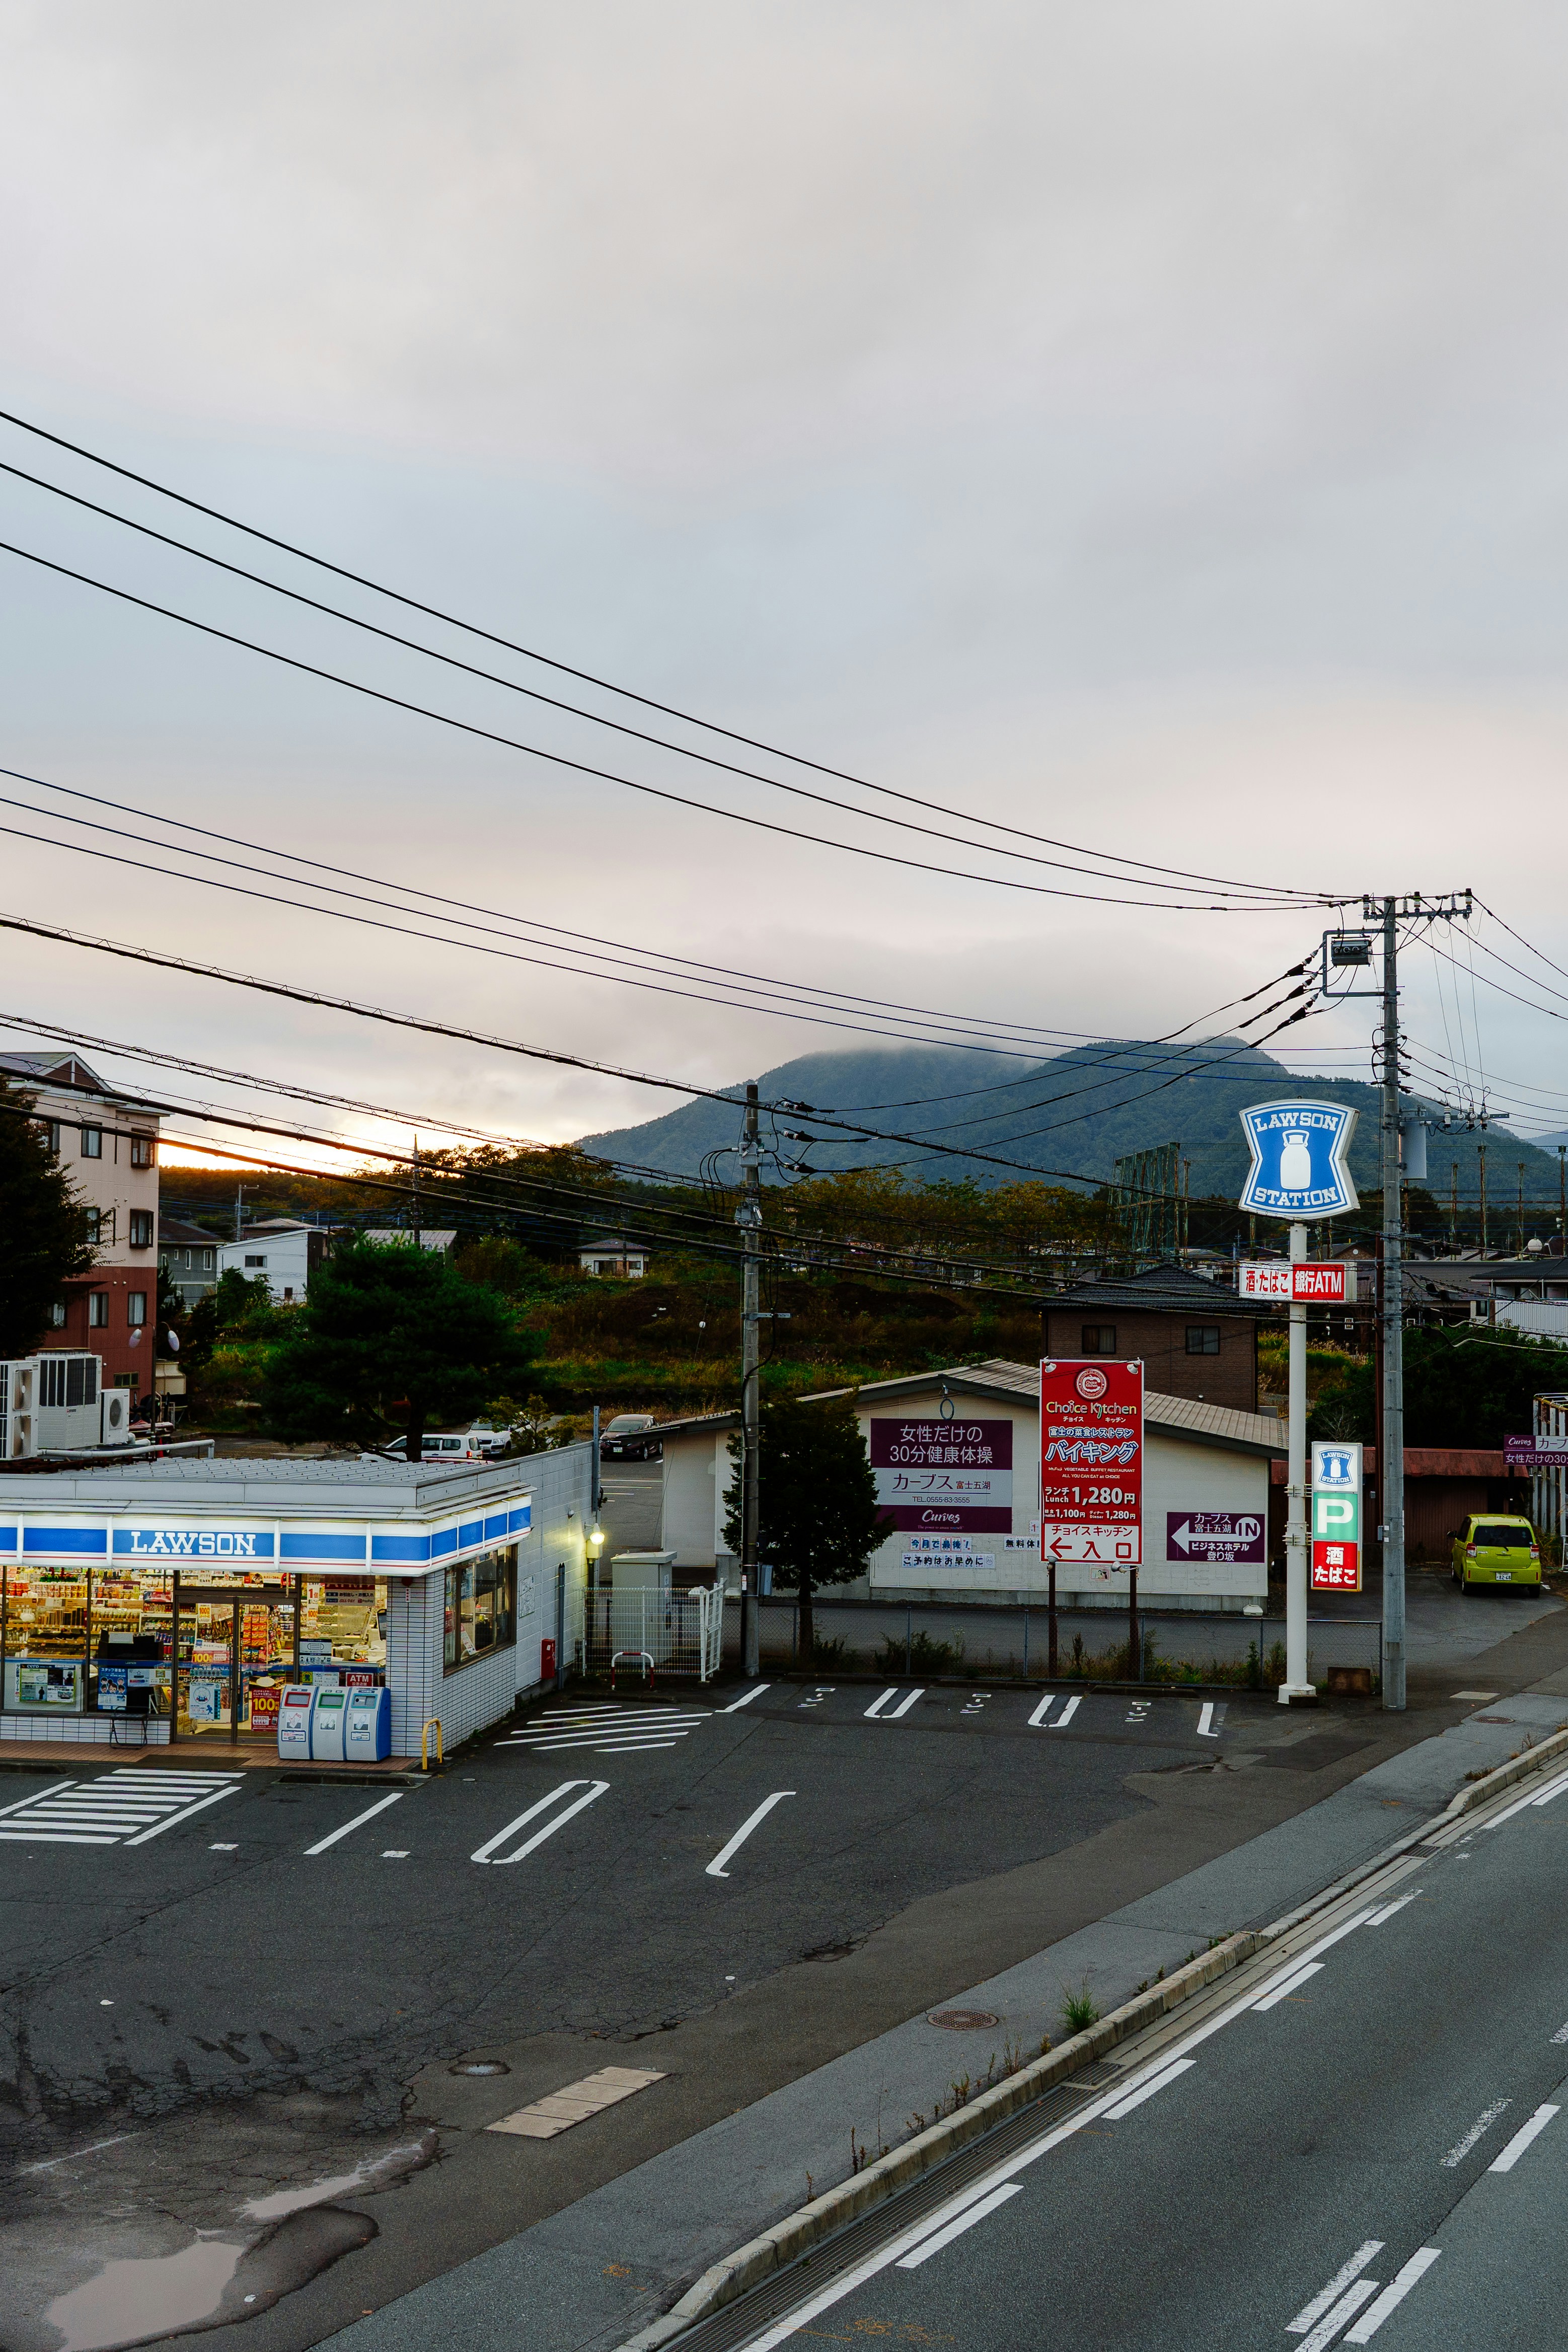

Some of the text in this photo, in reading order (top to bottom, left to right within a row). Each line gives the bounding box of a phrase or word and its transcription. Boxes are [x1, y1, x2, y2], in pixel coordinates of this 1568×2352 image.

[1254, 1112, 1338, 1132] LAWSON
[1254, 1187, 1338, 1206] STATION
[1246, 1270, 1341, 1293] 酒・たばこ 銀行ATM
[1047, 1400, 1137, 1419] Choice Kitchen
[901, 1425, 982, 1442] 女性だけの
[1049, 1426, 1134, 1438] 富士の菜食レストラン
[889, 1445, 993, 1464] 30分健康体操
[1045, 1439, 1139, 1464] バイキング
[1506, 1454, 1568, 1463] 女性だけの30
[892, 1473, 991, 1490] カーブス 富士五湖
[1045, 1487, 1135, 1505] ランチ 1,280円
[922, 1510, 960, 1523] Curves
[1056, 1509, 1085, 1518] 1,100円
[1105, 1511, 1136, 1519] 1,280円
[1194, 1513, 1231, 1523] カーブス
[1317, 1498, 1353, 1533] P
[1194, 1524, 1231, 1533] 富士五湖
[1238, 1523, 1257, 1536] IN
[131, 1531, 256, 1555] LAWSON
[1191, 1542, 1249, 1551] ビジネスホテル
[903, 1556, 984, 1566] ご予約はお早めに
[1207, 1552, 1234, 1561] 登り坂
[1326, 1546, 1344, 1565] 酒
[1315, 1566, 1356, 1584] たばこ
[253, 1698, 275, 1711] 100
